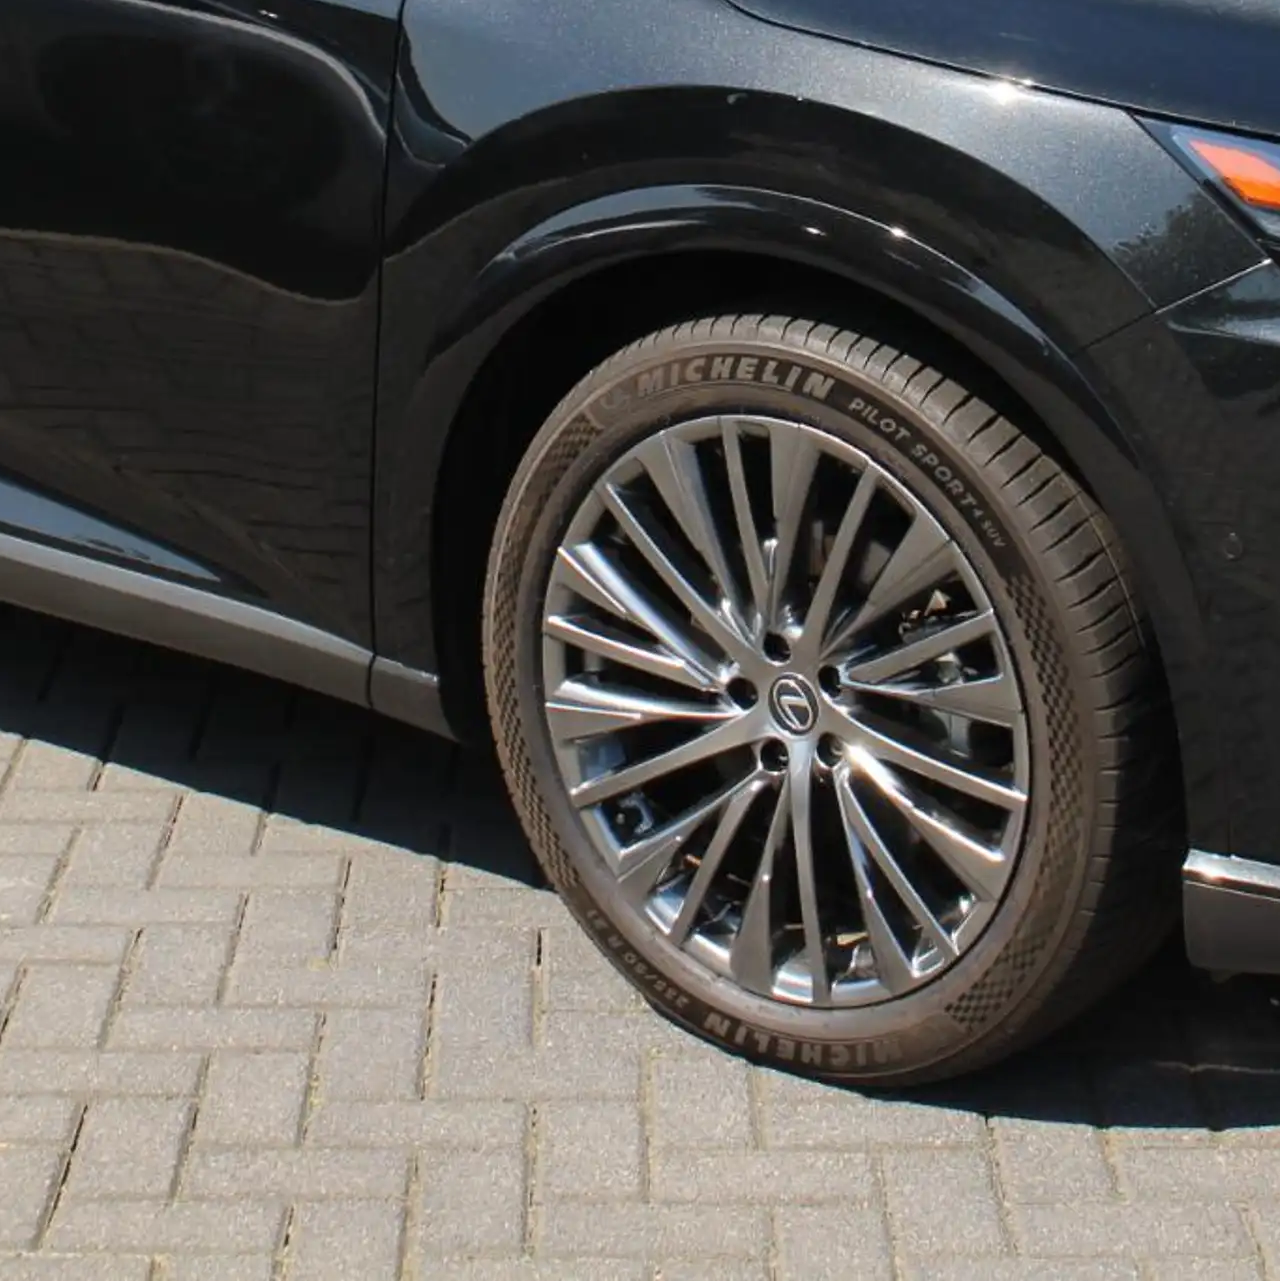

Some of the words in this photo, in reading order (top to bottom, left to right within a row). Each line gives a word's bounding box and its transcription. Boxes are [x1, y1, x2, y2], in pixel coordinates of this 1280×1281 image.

[636, 356, 836, 400] MICHELIN
[847, 397, 912, 442] PILOT
[911, 443, 977, 507] SPORT
[981, 520, 1007, 548] SUV
[702, 1011, 904, 1067] MICHELIN
